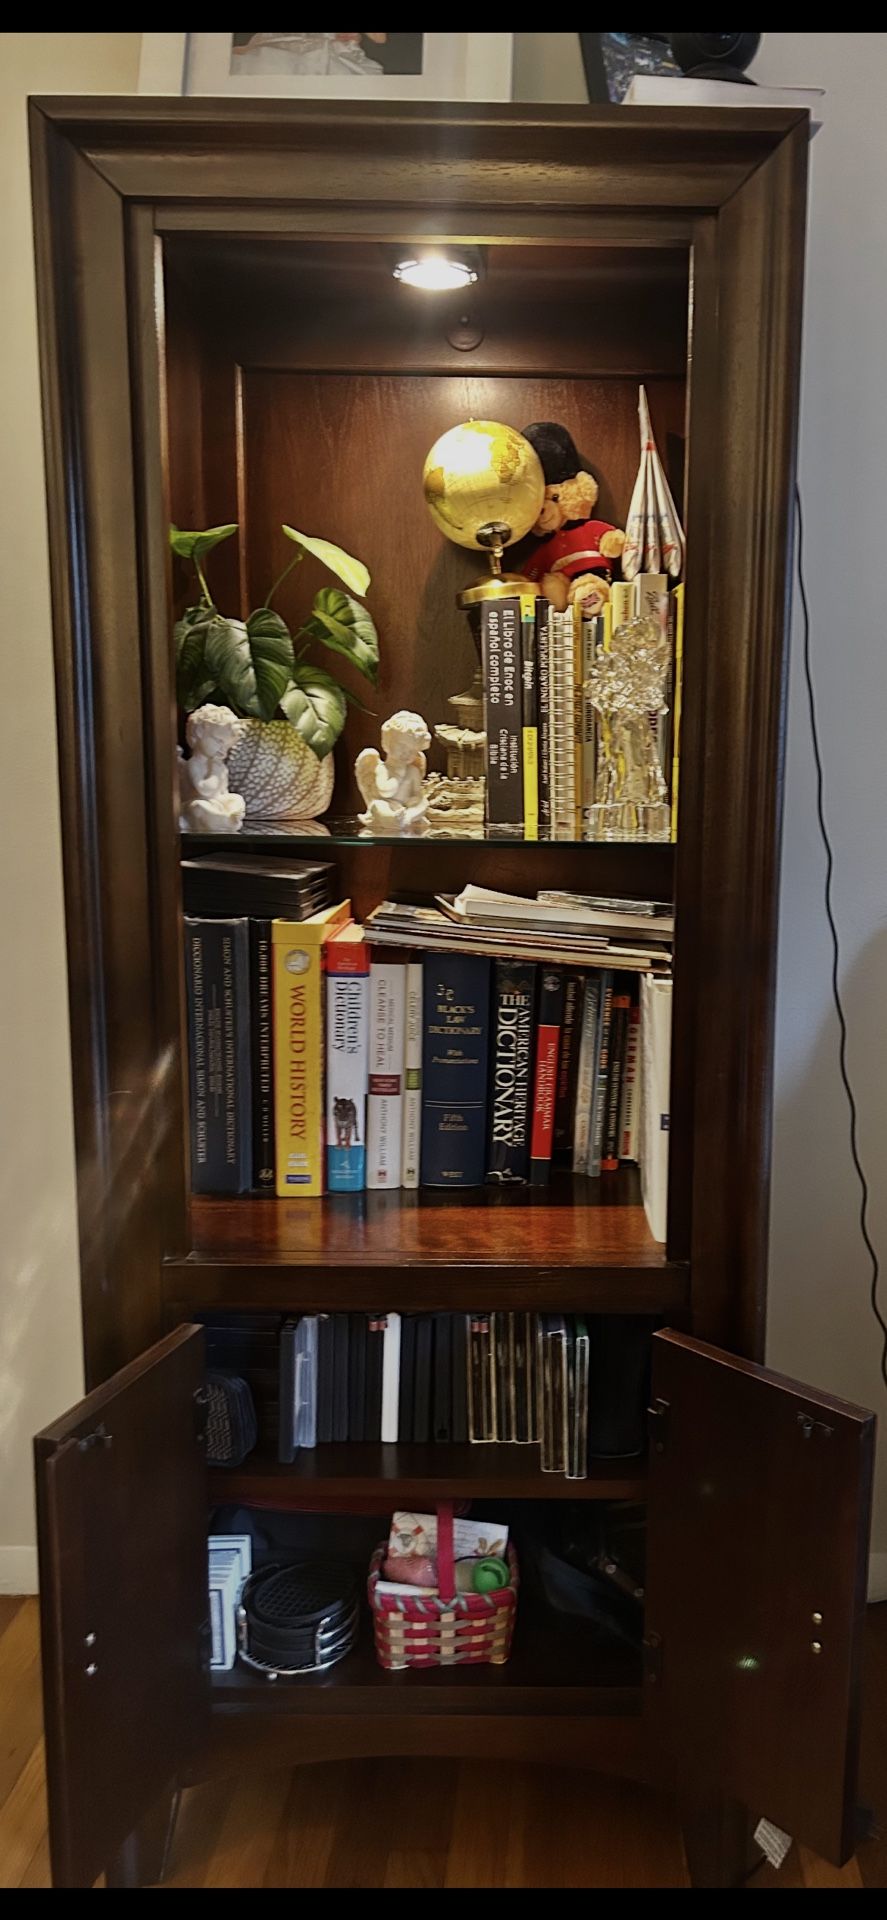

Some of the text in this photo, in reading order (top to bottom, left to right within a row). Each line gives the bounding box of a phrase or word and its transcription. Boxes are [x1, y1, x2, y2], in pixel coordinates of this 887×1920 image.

[488, 611, 501, 704] español completo
[503, 610, 516, 706] El Libro de Enoc en
[540, 626, 549, 668] POPULISTA
[522, 660, 534, 690] Bitcoin
[539, 669, 549, 703] ENGAÑO
[585, 702, 593, 742] IGNORANCIA
[490, 744, 499, 765] Biblia
[500, 729, 509, 780] Cristiana de la
[510, 735, 519, 774] Institución
[223, 937, 232, 965] SIMON
[223, 967, 233, 988] AND
[258, 940, 270, 1093] 10,000 DREAMS INTERPRETED
[290, 984, 307, 1053] WORLD
[332, 980, 350, 1053] Dictionary
[347, 980, 363, 1054] Children's
[376, 979, 387, 1069] CLEANSE TO HEAL
[500, 994, 530, 1006] THE
[603, 987, 613, 1026] EVIDENCE
[192, 937, 207, 1164] DICCIONARIO INTERNACIONAL SIMON AND SCHUSTER
[225, 1039, 236, 1109] INTERNATIONAL
[493, 1006, 519, 1148] DICTIONARY
[512, 1007, 531, 1147] AMERICAN HERITAGE
[625, 1027, 638, 1083] GERMAN
[289, 1060, 307, 1141] HISTORY
[536, 1060, 547, 1113] HANDBOOK
[542, 1042, 557, 1131] ENGLISH GRAMMAR
[226, 1111, 236, 1165] DICTIONARY
[379, 1098, 388, 1133] ANTHONY
[378, 1134, 388, 1166] WILLIAM
